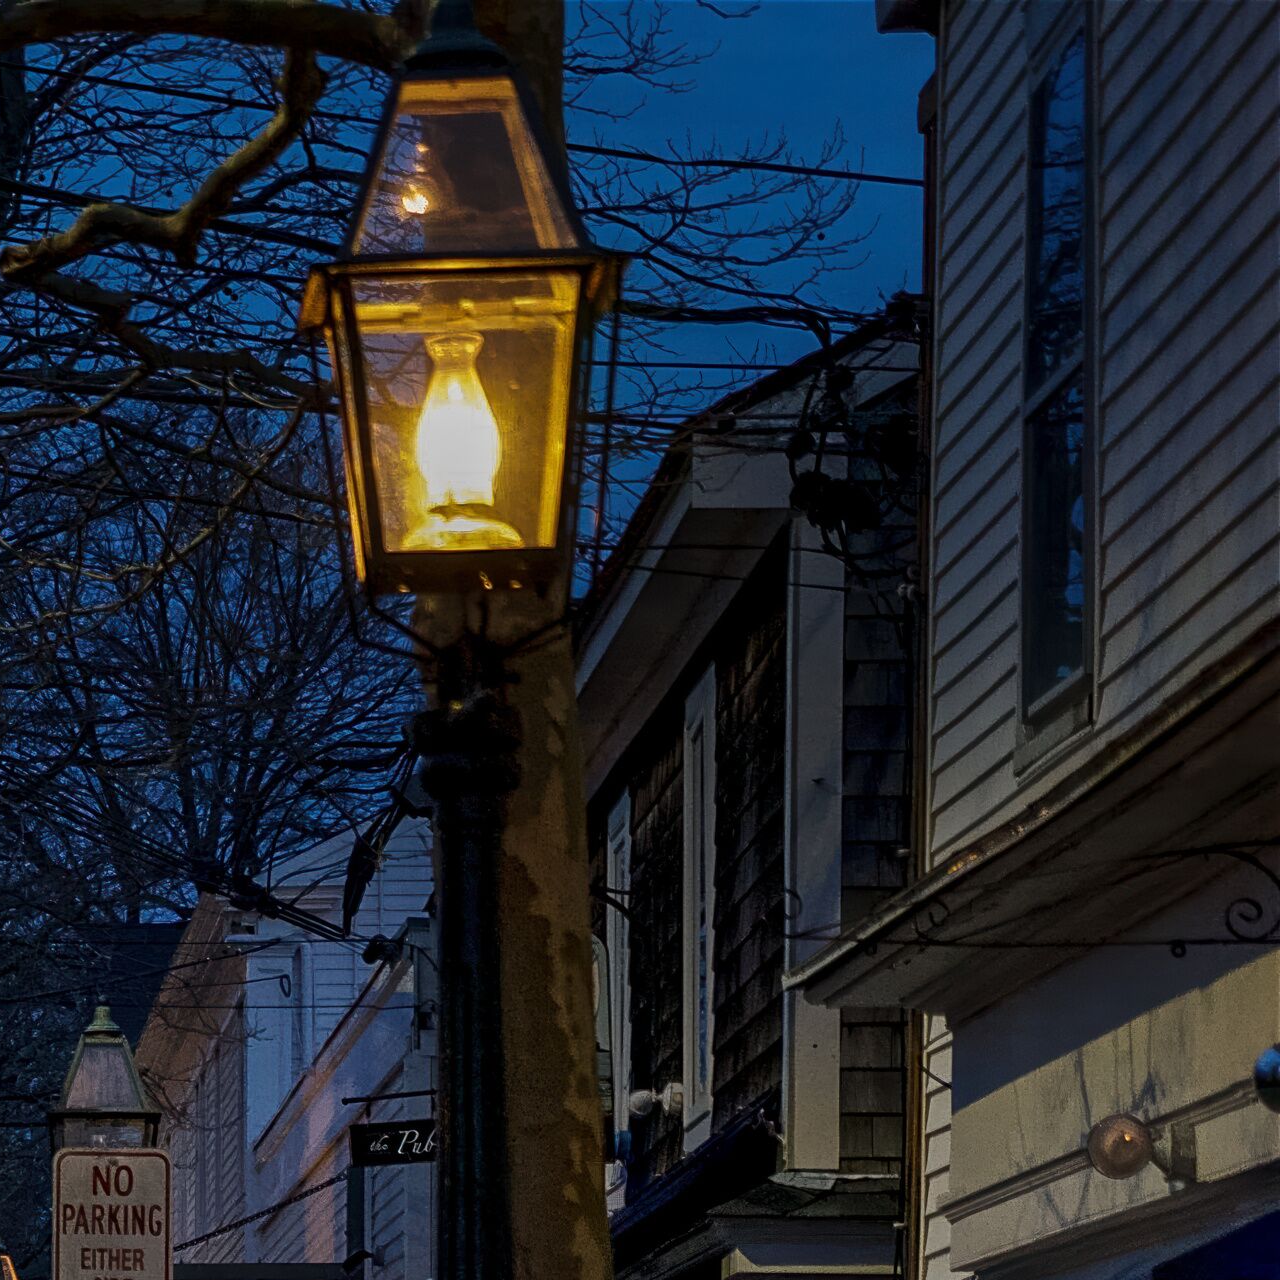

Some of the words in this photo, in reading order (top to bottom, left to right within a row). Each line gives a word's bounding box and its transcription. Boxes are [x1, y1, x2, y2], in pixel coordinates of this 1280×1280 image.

[92, 1165, 133, 1197] NO
[62, 1203, 162, 1237] PARKING
[80, 1247, 145, 1271] EITHER
